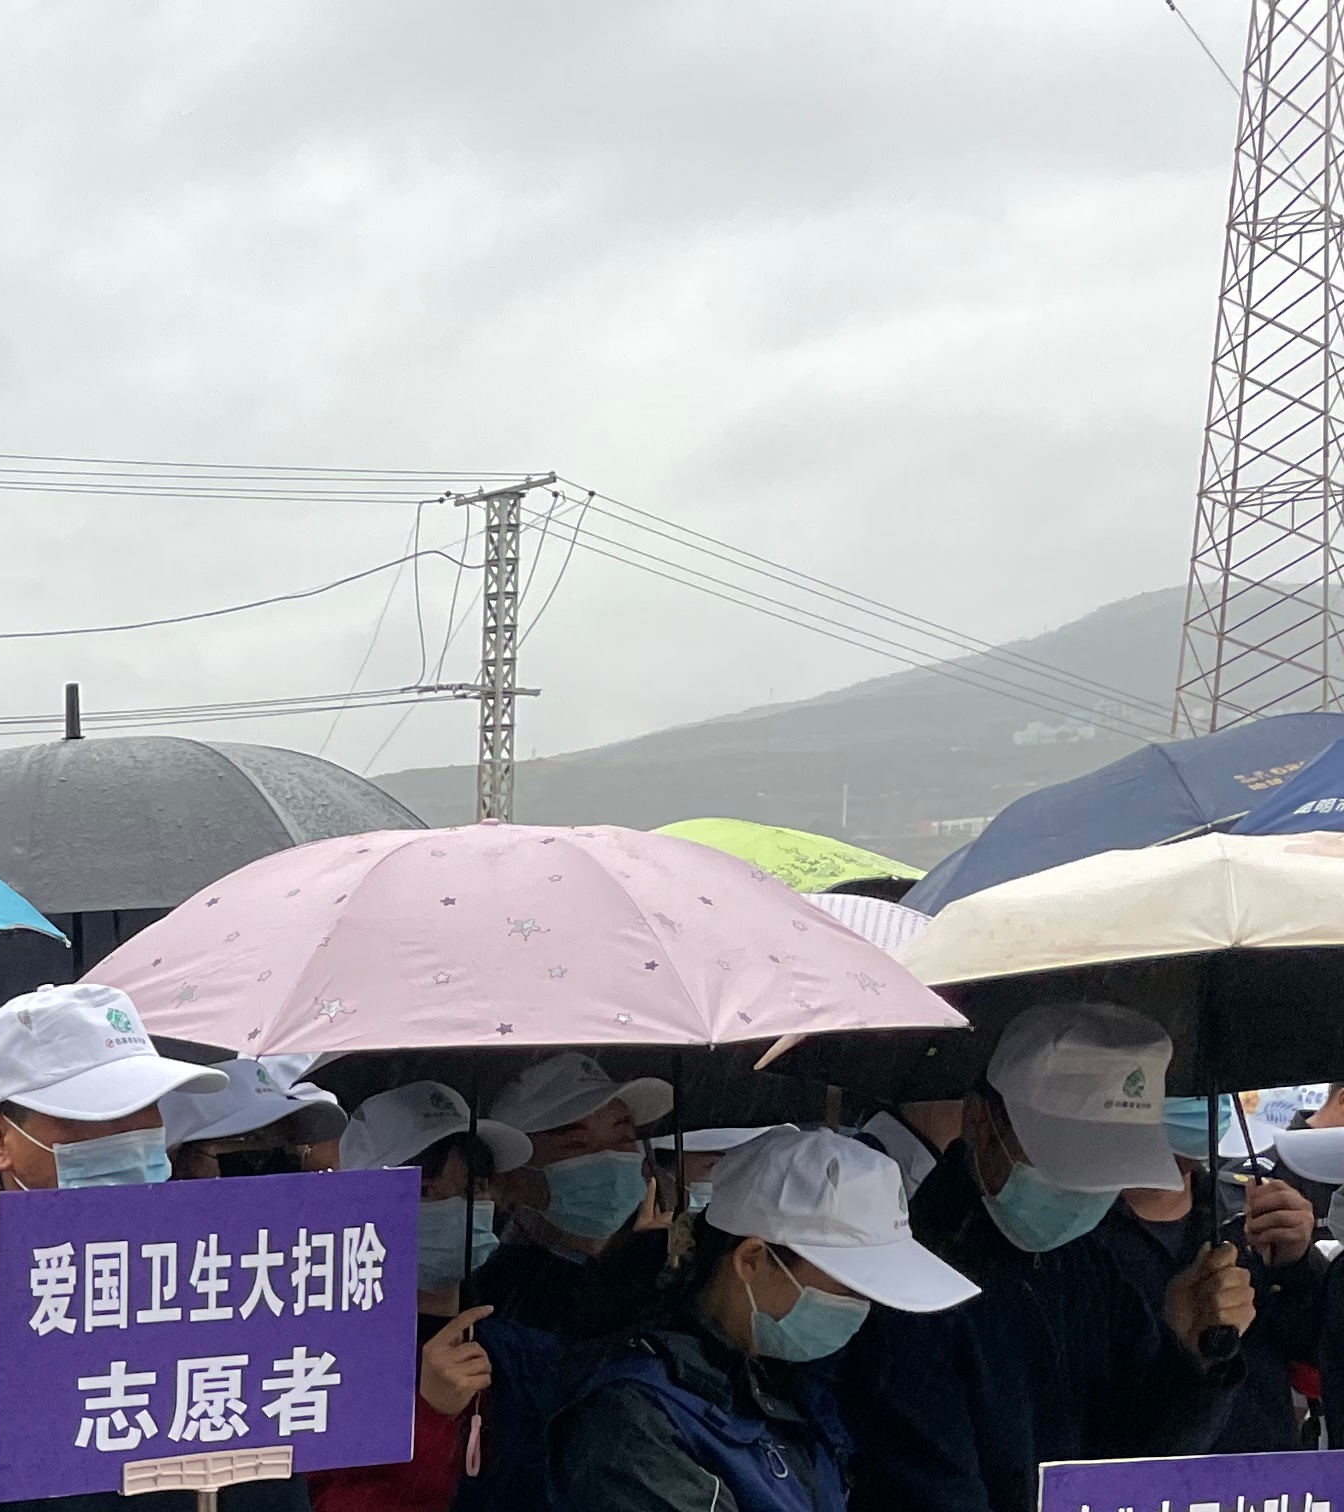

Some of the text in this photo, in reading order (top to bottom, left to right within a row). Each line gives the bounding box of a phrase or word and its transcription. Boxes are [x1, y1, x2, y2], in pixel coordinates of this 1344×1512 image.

[28, 1222, 387, 1337] 爱国卫生大扫除
[74, 1346, 341, 1452] 志愿者
